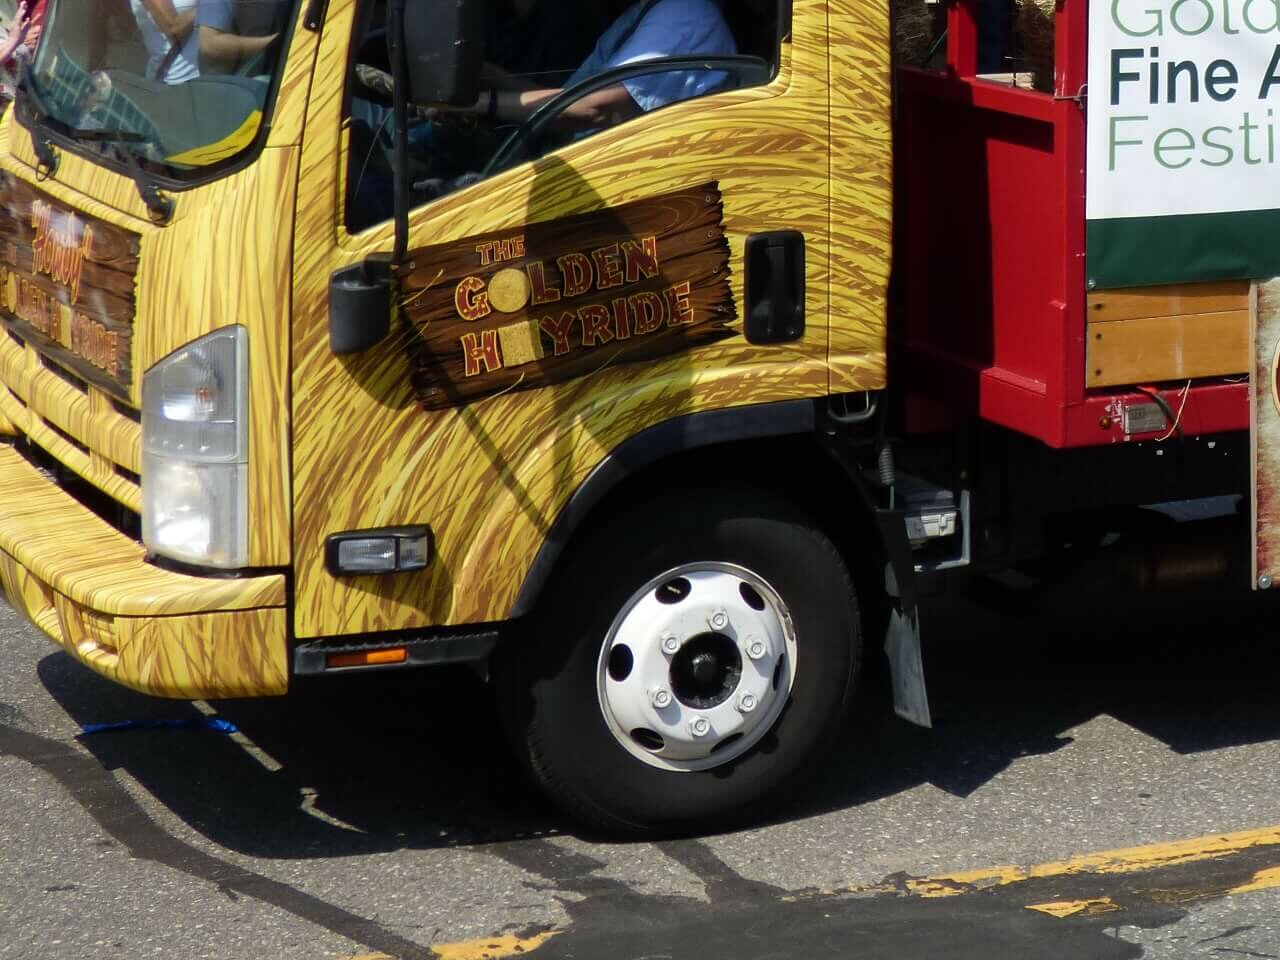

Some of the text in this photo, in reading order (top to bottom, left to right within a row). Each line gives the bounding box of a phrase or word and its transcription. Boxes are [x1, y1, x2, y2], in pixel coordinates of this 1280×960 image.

[1110, 45, 1239, 106] Fine
[453, 235, 659, 322] GOLDEN
[476, 236, 526, 266] THE
